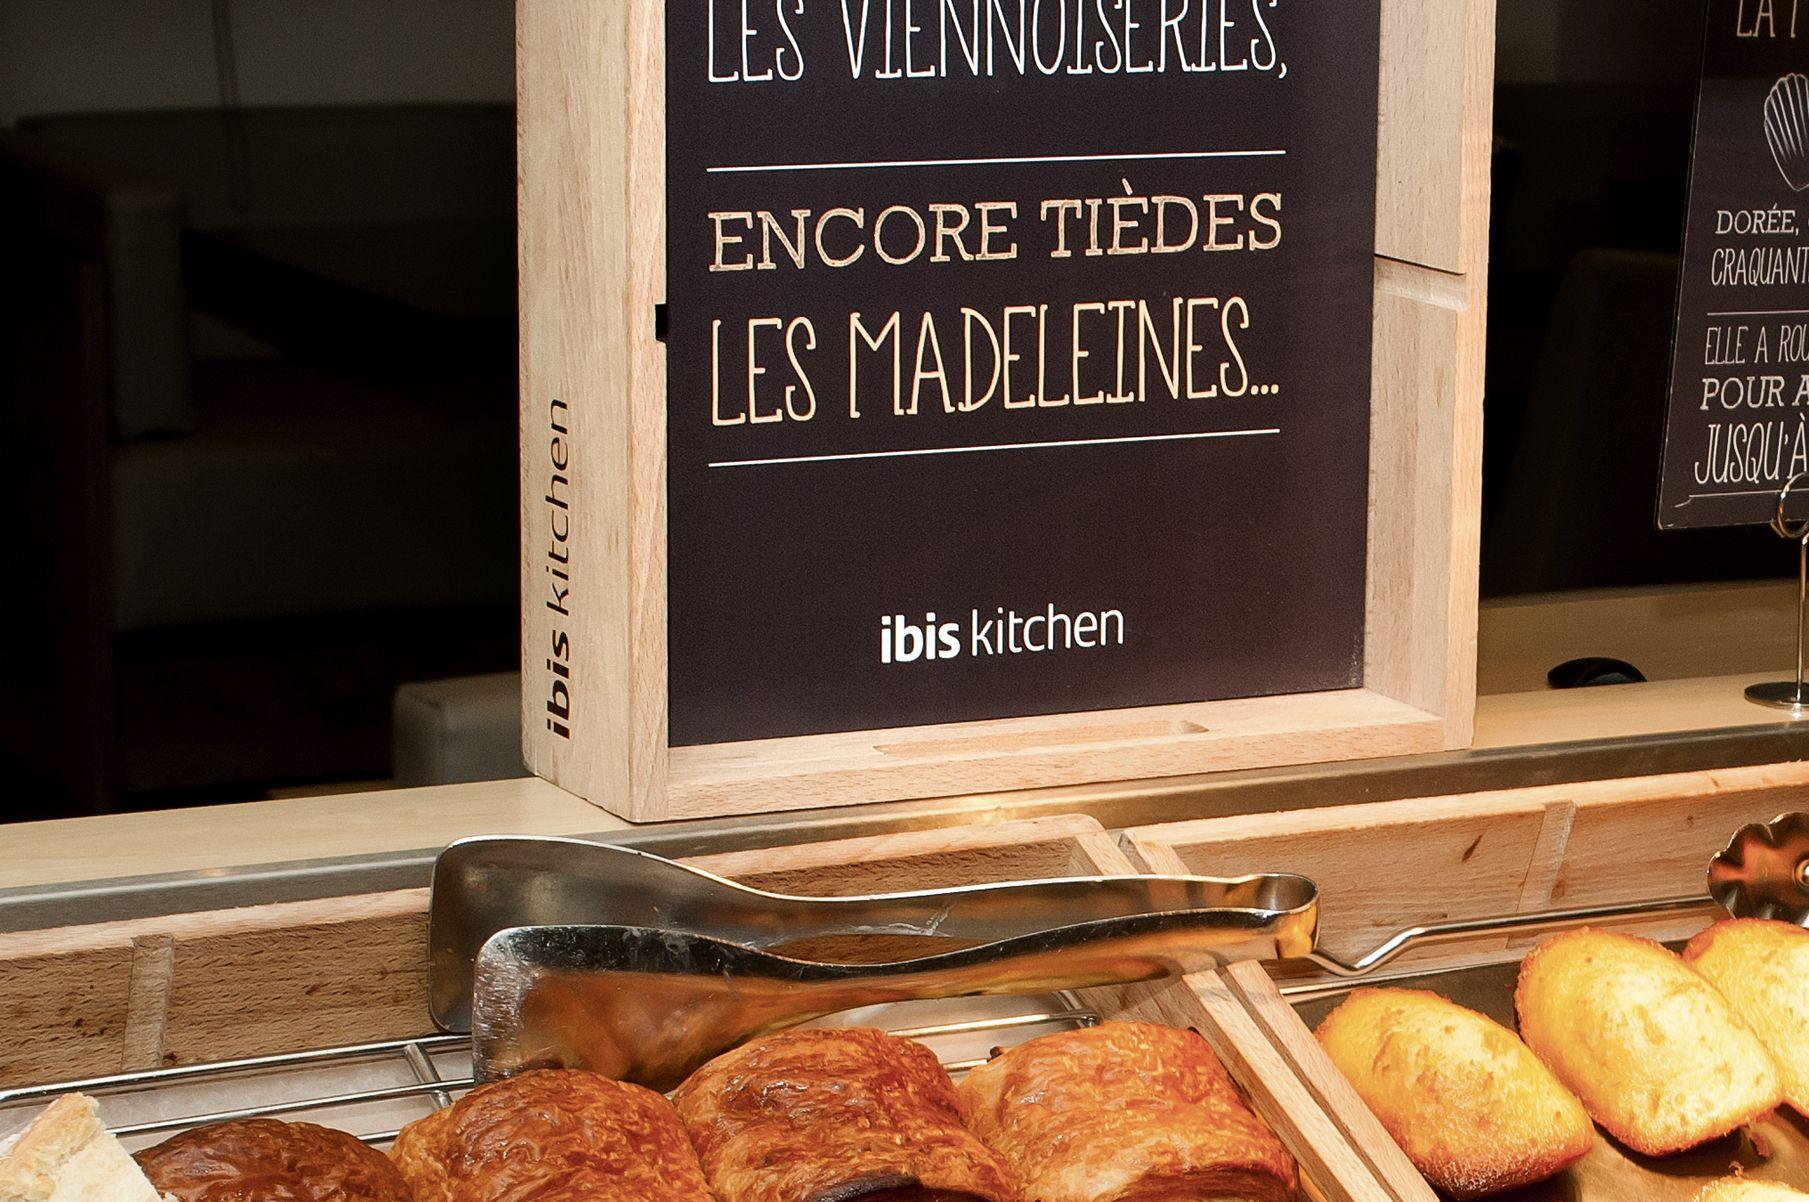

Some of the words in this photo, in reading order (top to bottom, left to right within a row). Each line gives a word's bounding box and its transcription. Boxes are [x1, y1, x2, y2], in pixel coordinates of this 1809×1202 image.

[708, 0, 804, 83] LES
[840, 0, 1288, 80] VIENNOISERIES,
[1736, 0, 1776, 38] LA
[707, 202, 1019, 273] ENCORE
[1040, 178, 1283, 259] TIÈDES
[1715, 202, 1799, 237] DORÉE,
[711, 315, 818, 427] LES
[849, 295, 1281, 420] MADELEINES...
[1704, 326, 1749, 365] ELLE
[1753, 326, 1769, 364] A
[1699, 375, 1786, 411] POUR
[1693, 412, 1809, 484] JUSQU'À
[545, 399, 569, 617] kitchen
[881, 612, 961, 664] ibis
[971, 602, 1125, 657] kitchen
[545, 629, 571, 740] ibis
